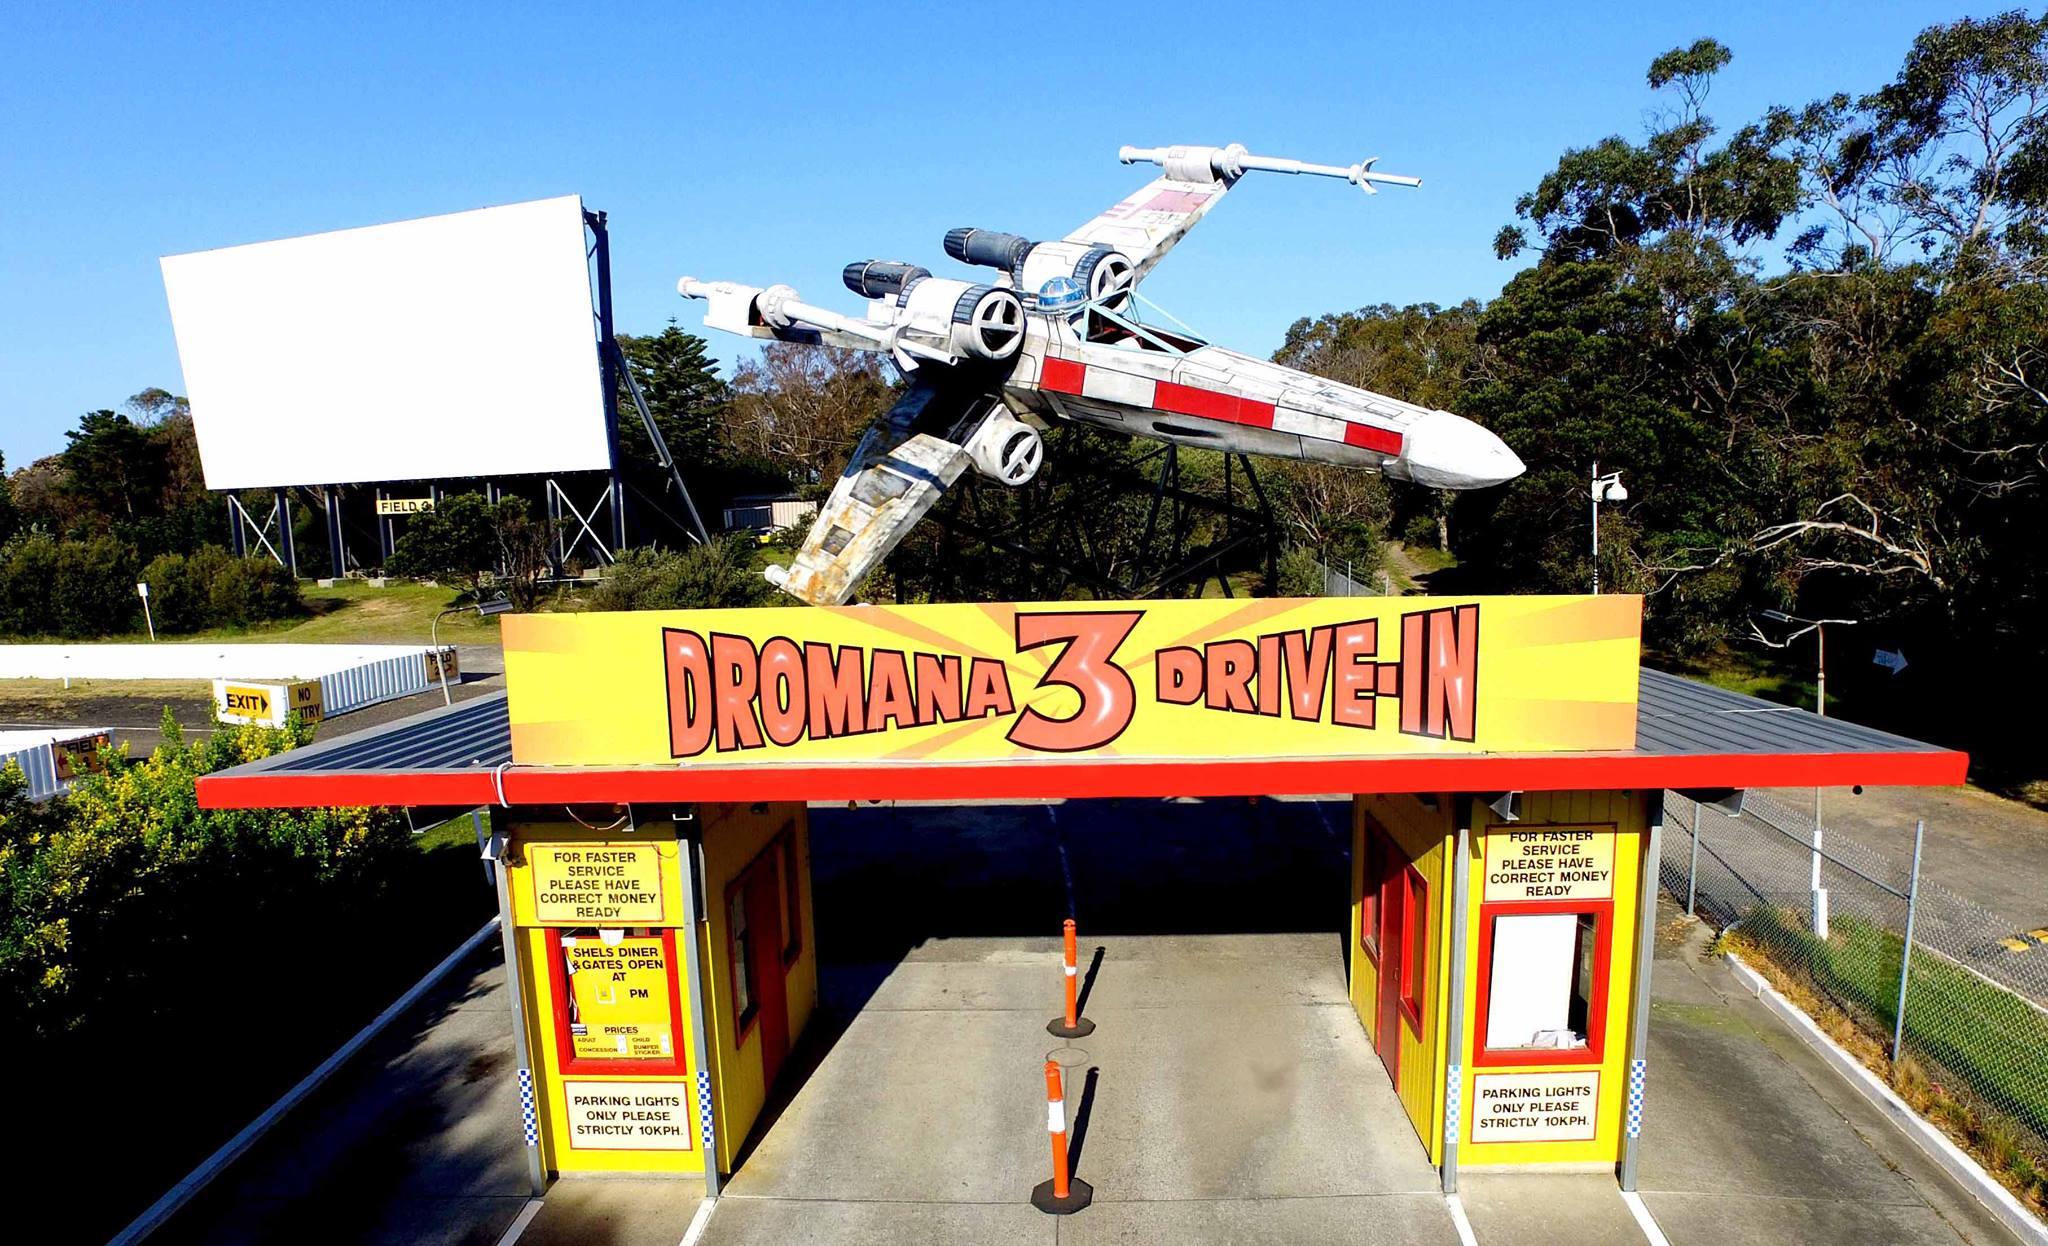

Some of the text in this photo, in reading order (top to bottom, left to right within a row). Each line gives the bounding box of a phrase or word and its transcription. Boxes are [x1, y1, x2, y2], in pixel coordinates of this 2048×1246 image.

[381, 501, 417, 512] FIELD
[661, 603, 1480, 759] DROMANA 3 DRIVE-IN
[298, 688, 311, 702] NO
[226, 693, 259, 710] EXIT
[291, 704, 320, 719] NTRY
[1510, 830, 1593, 842] FOR FASTER
[1522, 844, 1580, 856] SERVICE
[554, 852, 636, 863] FOR FASTER
[1502, 858, 1594, 870] PLEASE HAVE
[568, 866, 625, 876] SERVICE
[1490, 871, 1609, 884] CORRECT MONEY
[550, 879, 640, 890] PLEASE HAVE
[1526, 885, 1572, 896] READY
[540, 893, 656, 904] CORRECT MONEY
[576, 907, 621, 918] READY
[573, 947, 658, 958] SHELS DINER
[628, 959, 664, 969] OPEN
[612, 972, 627, 981] AT
[629, 989, 649, 998] PM
[604, 1026, 638, 1034] PRICES
[1482, 1086, 1591, 1098] PARKING LIGHTS
[574, 1096, 680, 1106] PARKING LIGHTS
[1493, 1101, 1579, 1113] ONLY PLEASE
[586, 1110, 671, 1121] ONLY PLEASE
[1480, 1117, 1539, 1128] STRICTLY
[577, 1125, 633, 1135] STRICTLY
